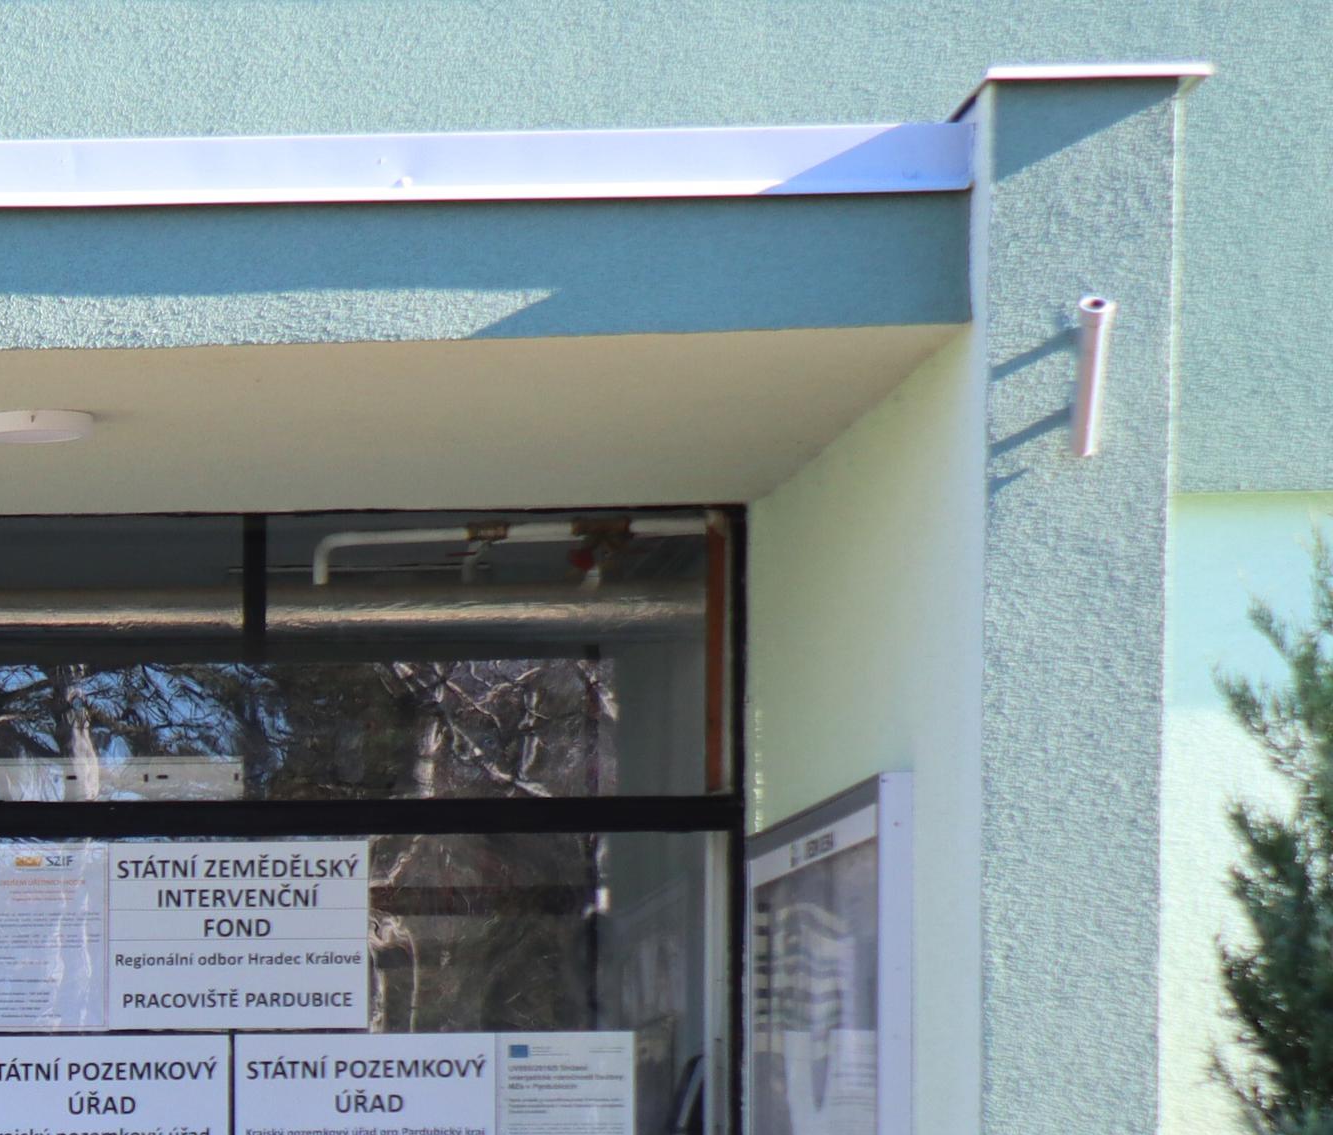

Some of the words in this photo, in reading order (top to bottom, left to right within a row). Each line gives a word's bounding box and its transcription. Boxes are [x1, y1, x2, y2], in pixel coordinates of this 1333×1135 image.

[45, 855, 74, 867] SZIF
[117, 855, 198, 879] STÁTNÍ
[204, 854, 359, 878] ZEMĚDĚLSKÝ
[158, 884, 320, 908] INTERVENČNÍ
[204, 918, 271, 937] FOND
[115, 953, 193, 969] Regionální
[198, 953, 243, 966] odbor
[248, 953, 301, 965] Hradec
[306, 952, 361, 965] Králové
[123, 989, 238, 1009] PRACOVIŠTĚ
[245, 992, 353, 1008] PARDUBICE
[68, 1056, 217, 1081] POZEMKOVÝ
[246, 1056, 328, 1080] STÁTNÍ
[335, 1054, 486, 1078] POZEMKOVÝ
[68, 1091, 136, 1115] ÚŘAD
[335, 1089, 404, 1113] ÚŘAD
